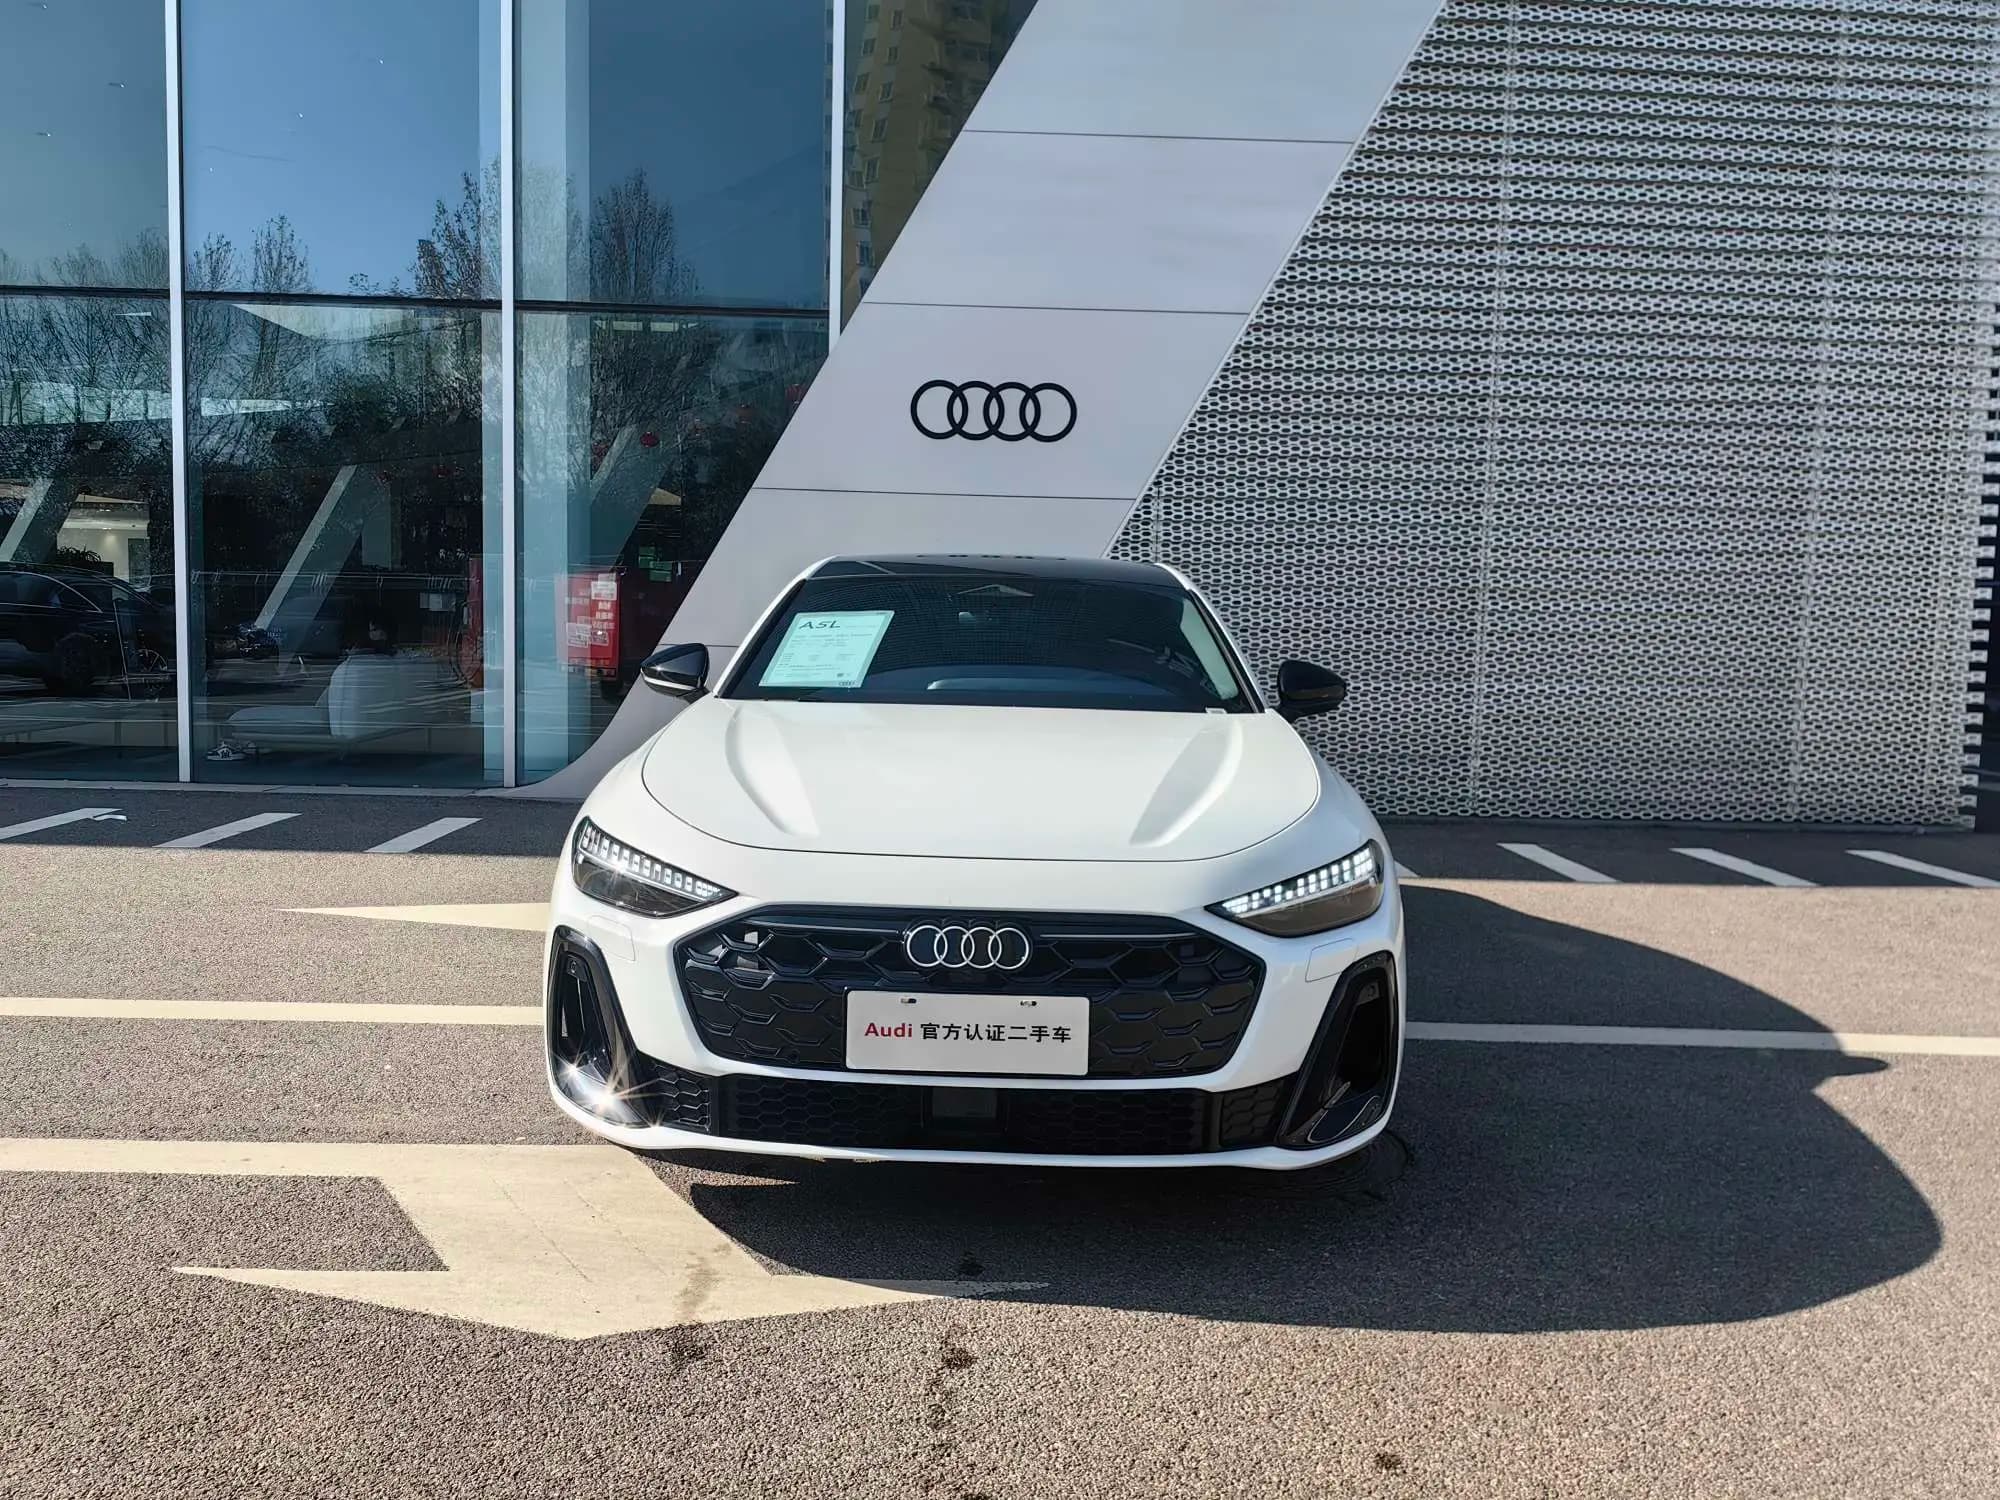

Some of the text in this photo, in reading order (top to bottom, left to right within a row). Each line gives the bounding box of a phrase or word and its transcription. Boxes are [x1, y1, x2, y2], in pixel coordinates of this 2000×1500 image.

[864, 1022, 1072, 1043] Audi 官方认证二手车
